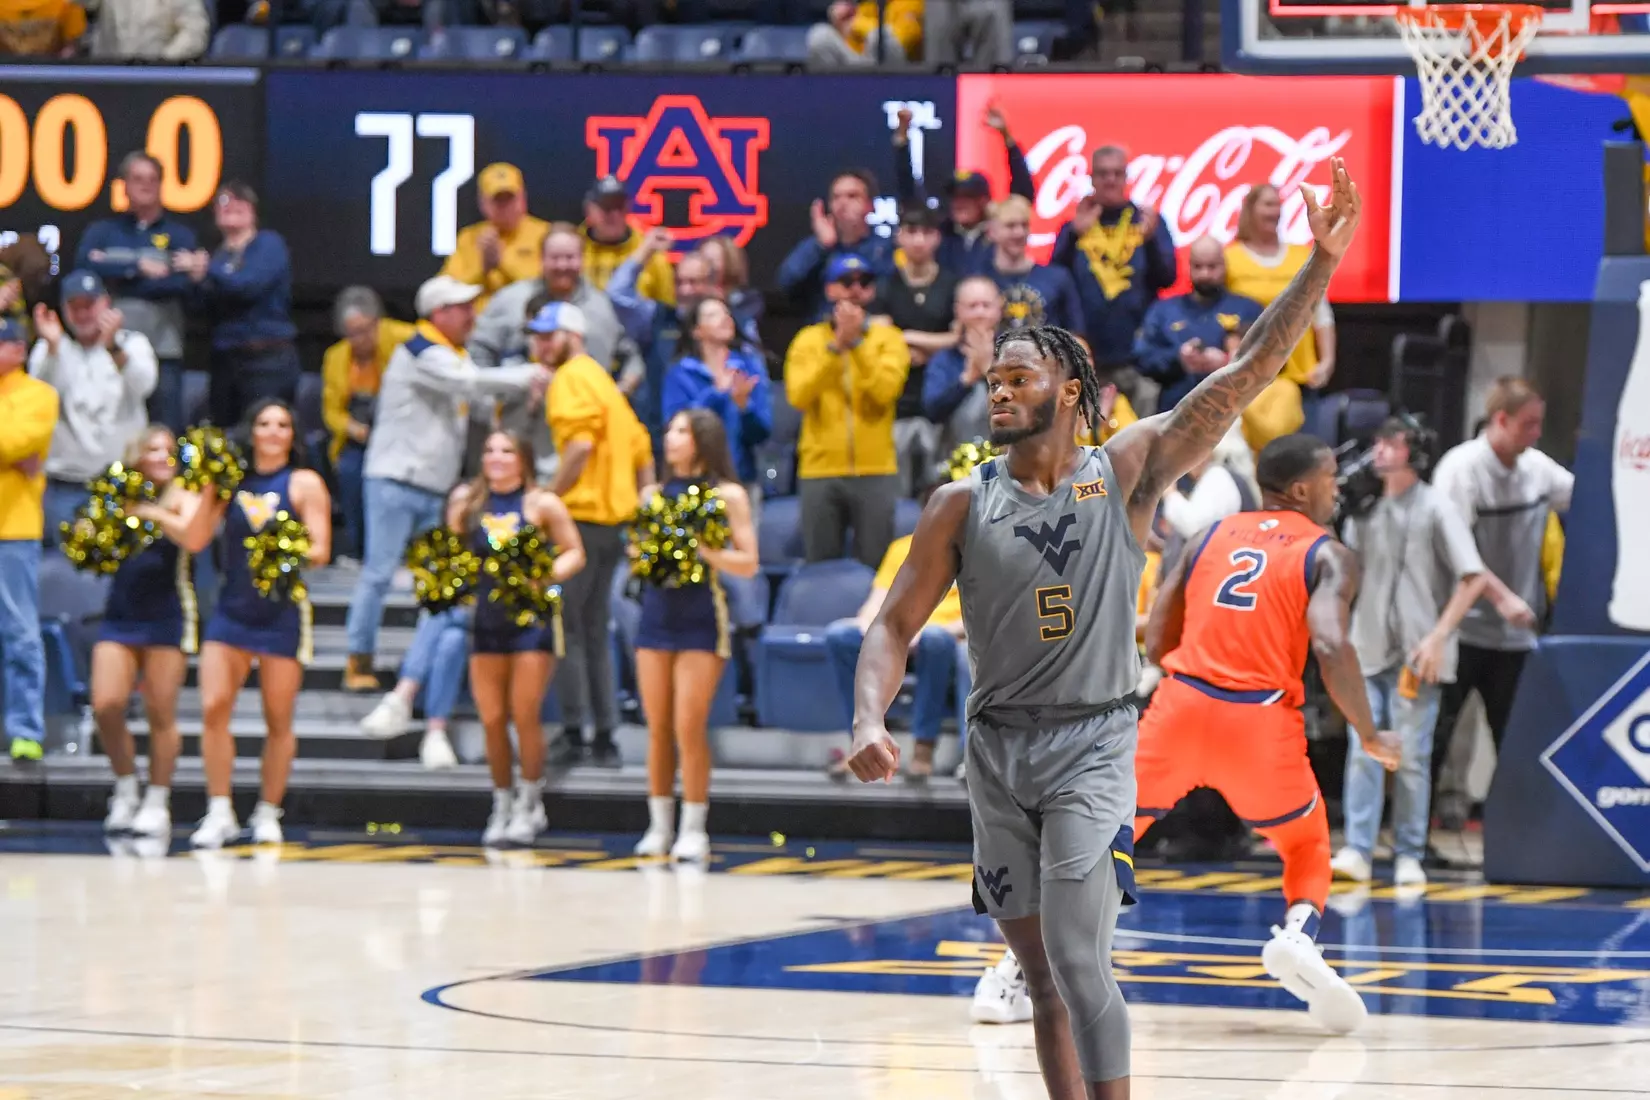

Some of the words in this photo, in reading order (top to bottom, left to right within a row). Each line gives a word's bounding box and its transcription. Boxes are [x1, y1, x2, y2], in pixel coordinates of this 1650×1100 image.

[354, 111, 476, 256] 77
[1212, 546, 1268, 612] 2
[1035, 584, 1075, 641] 5
